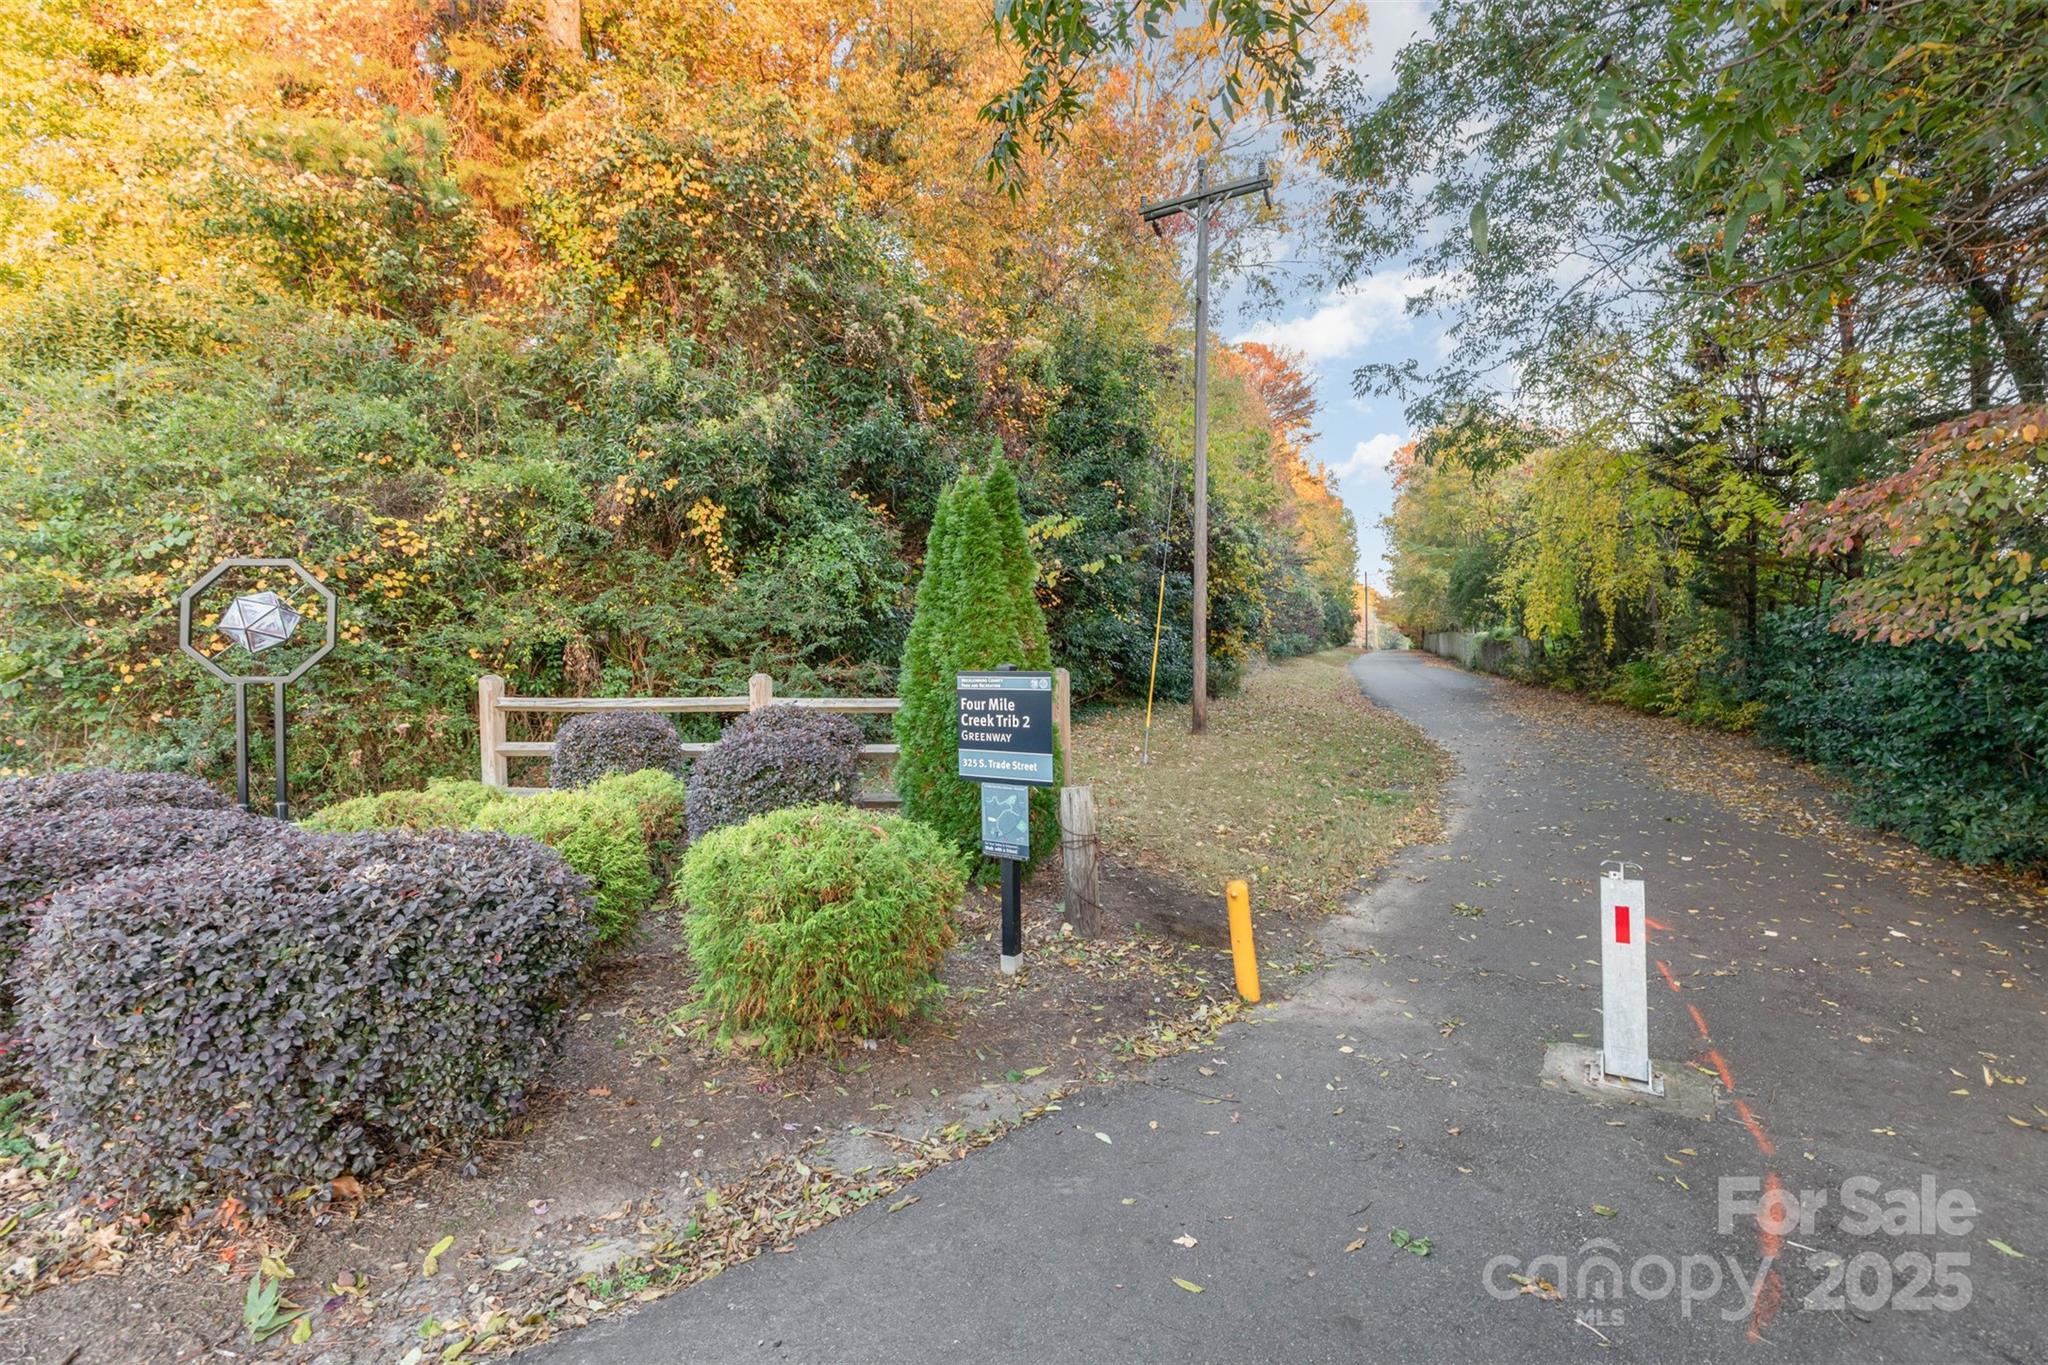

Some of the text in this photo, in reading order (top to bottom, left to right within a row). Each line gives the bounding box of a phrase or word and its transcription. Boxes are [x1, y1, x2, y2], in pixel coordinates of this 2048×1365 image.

[961, 698, 1015, 711] Four Mile
[961, 713, 1031, 728] Creek Trib 2
[961, 730, 1013, 743] GREENWAY
[963, 758, 1038, 772] 325 S. Trade Street
